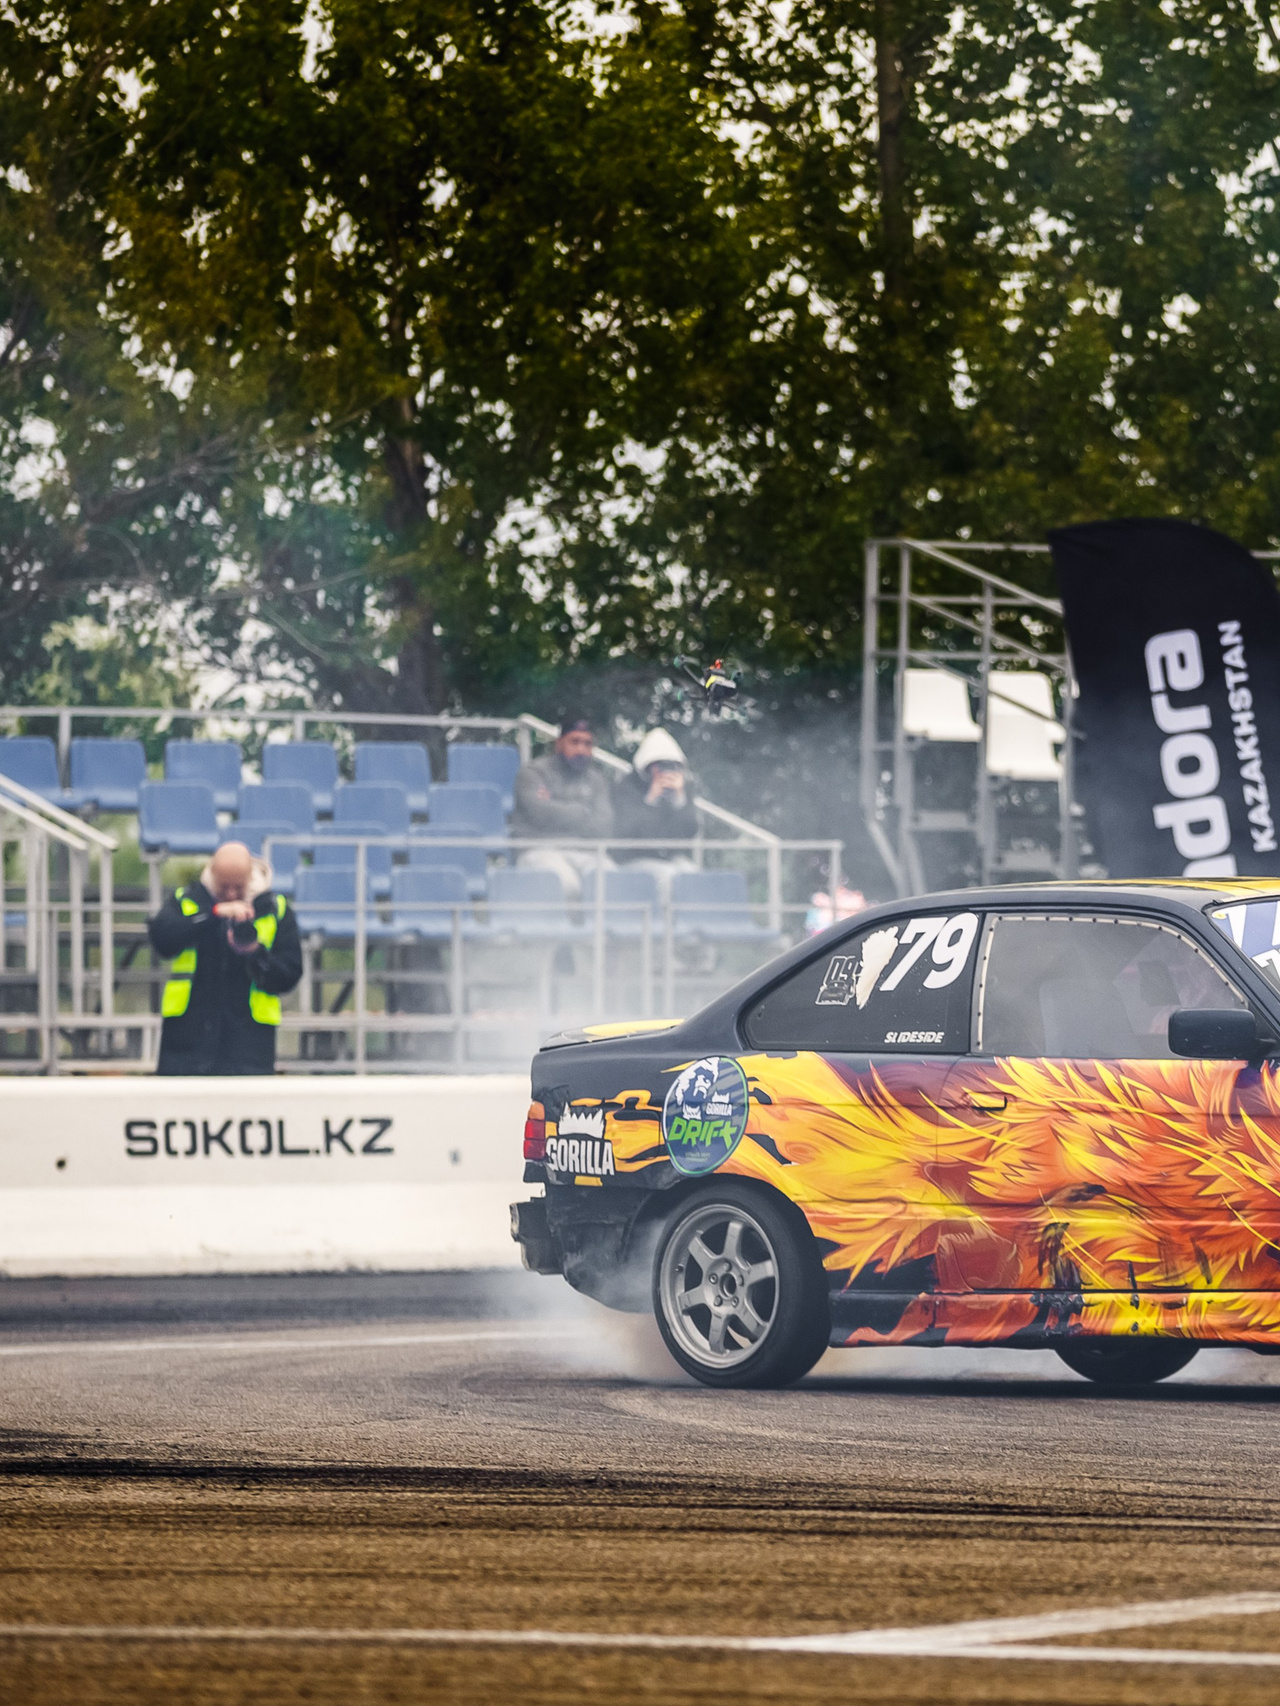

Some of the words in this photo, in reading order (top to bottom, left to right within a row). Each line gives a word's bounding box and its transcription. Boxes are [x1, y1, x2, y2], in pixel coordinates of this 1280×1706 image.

[1217, 619, 1278, 852] KAZAKHSTAN
[880, 912, 979, 991] 79
[884, 1031, 945, 1044] SLIDESIDE
[125, 1118, 394, 1156] SOKOL.KZ
[668, 1116, 737, 1150] DRIFT
[546, 1138, 615, 1176] GORILLA
